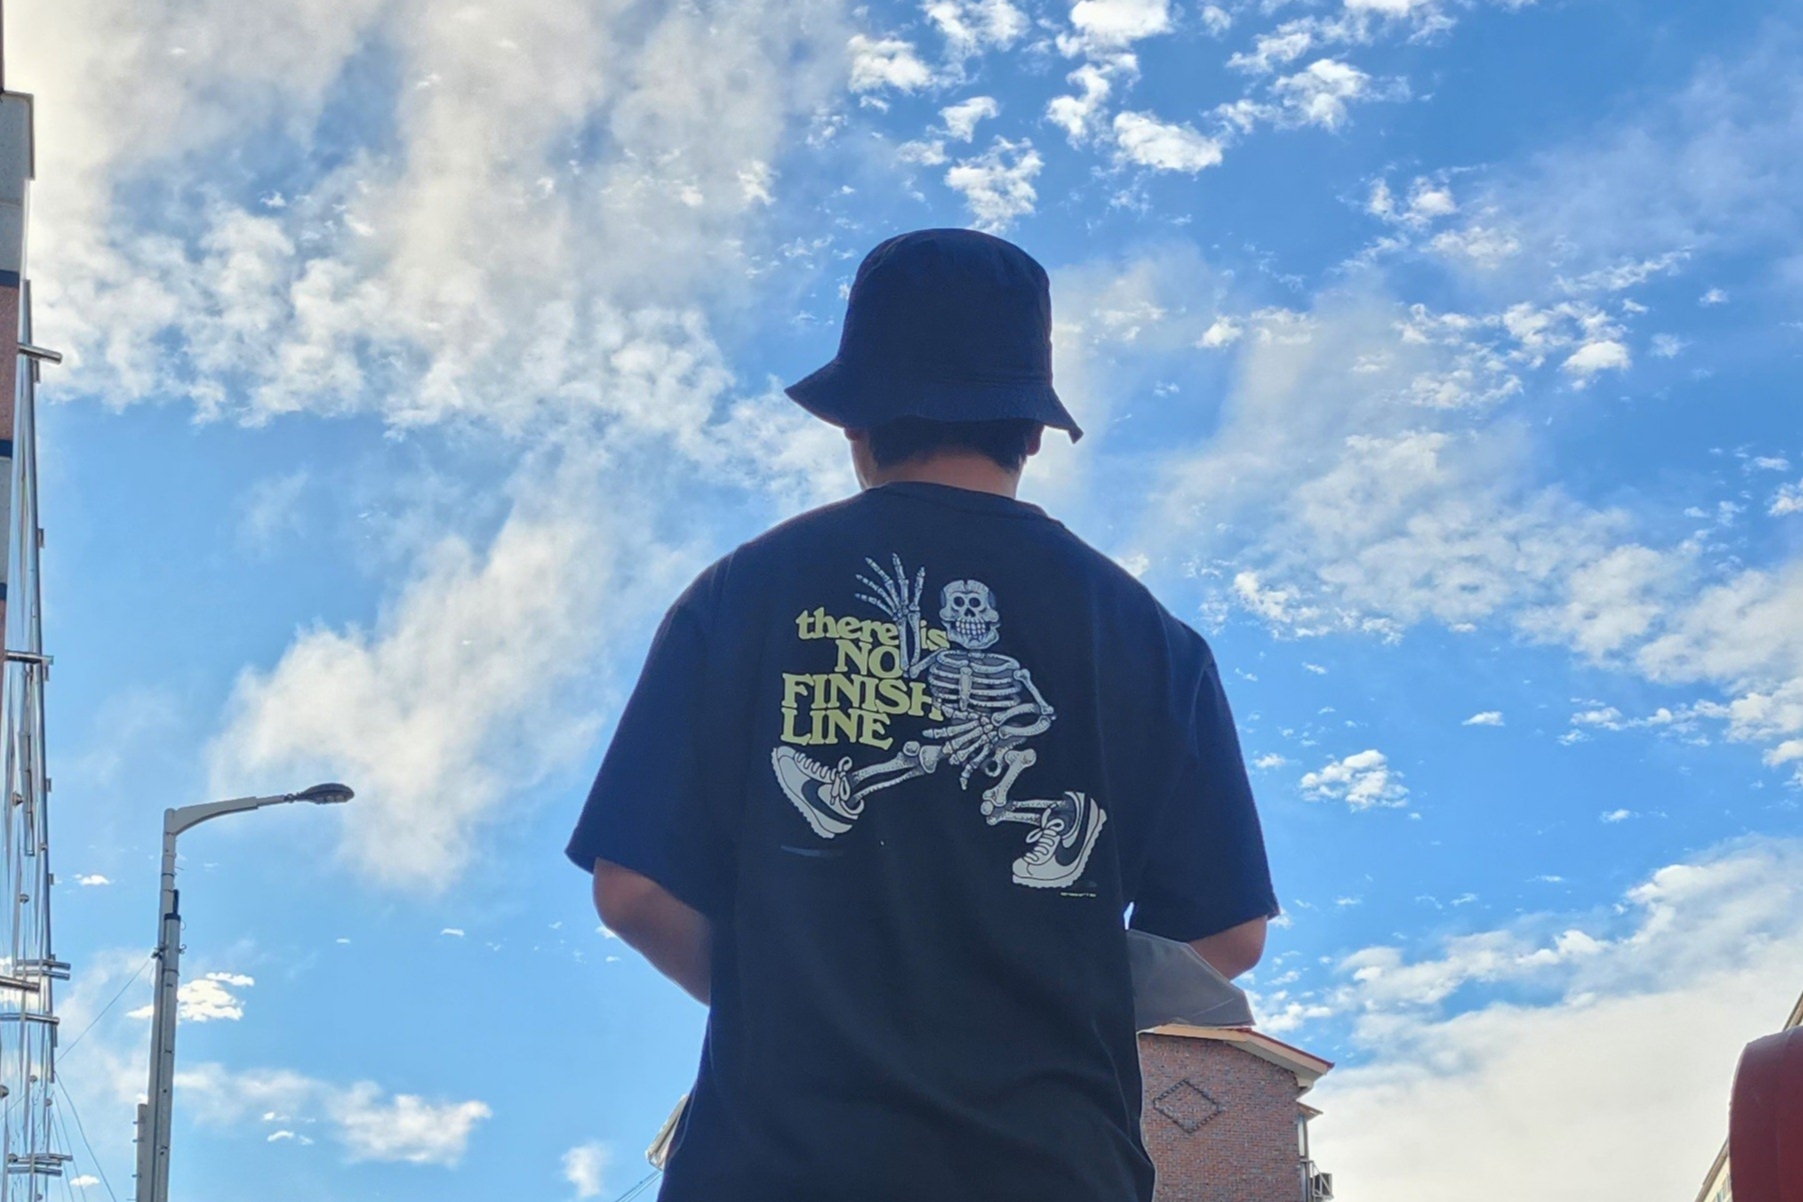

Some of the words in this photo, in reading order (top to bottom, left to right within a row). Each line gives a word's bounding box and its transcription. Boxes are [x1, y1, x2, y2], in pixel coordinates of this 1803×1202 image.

[796, 606, 899, 646] there
[919, 619, 950, 651] is
[834, 638, 904, 679] NO
[780, 706, 894, 750] LINE
